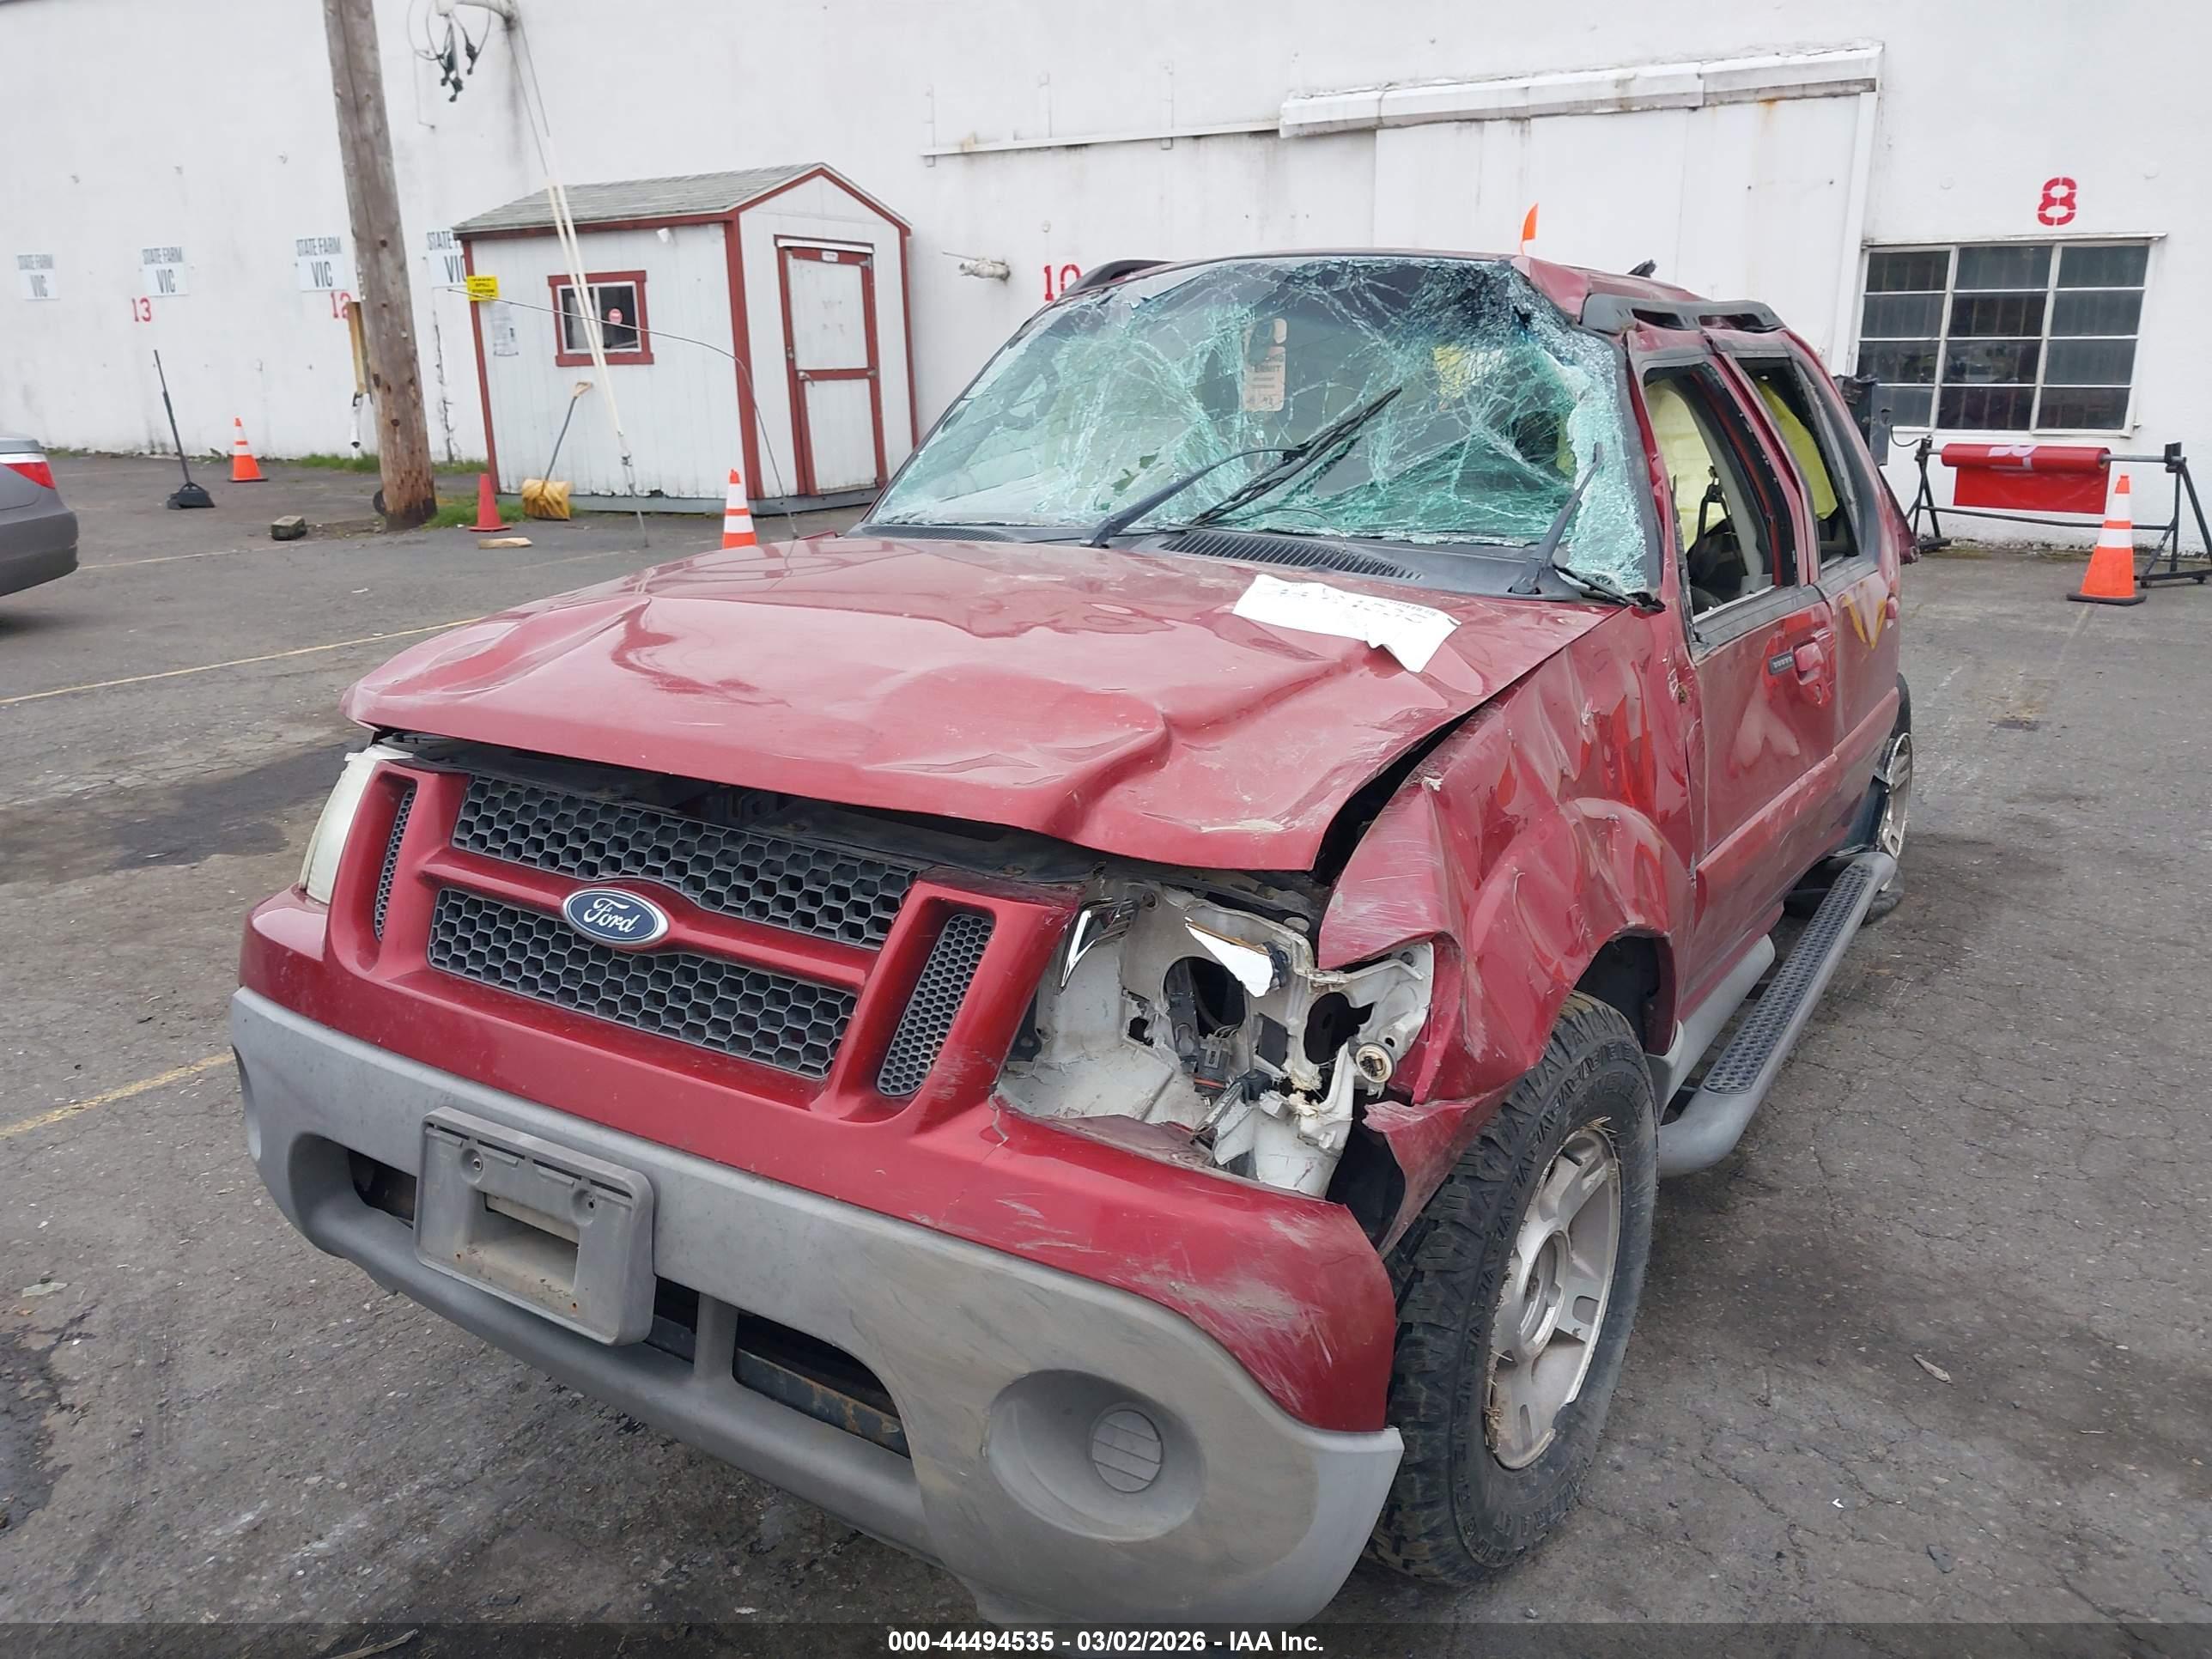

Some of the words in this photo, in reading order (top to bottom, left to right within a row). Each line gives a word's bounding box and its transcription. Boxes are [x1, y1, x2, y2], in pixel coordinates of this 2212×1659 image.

[2038, 177, 2076, 226] 8
[296, 239, 318, 257] STATE
[319, 237, 342, 254] FARM
[426, 231, 453, 250] STATE
[156, 269, 175, 294] VIC
[311, 261, 332, 288] VIC
[1044, 264, 1081, 301] 10
[131, 297, 152, 321] 13
[583, 897, 641, 934] Ford
